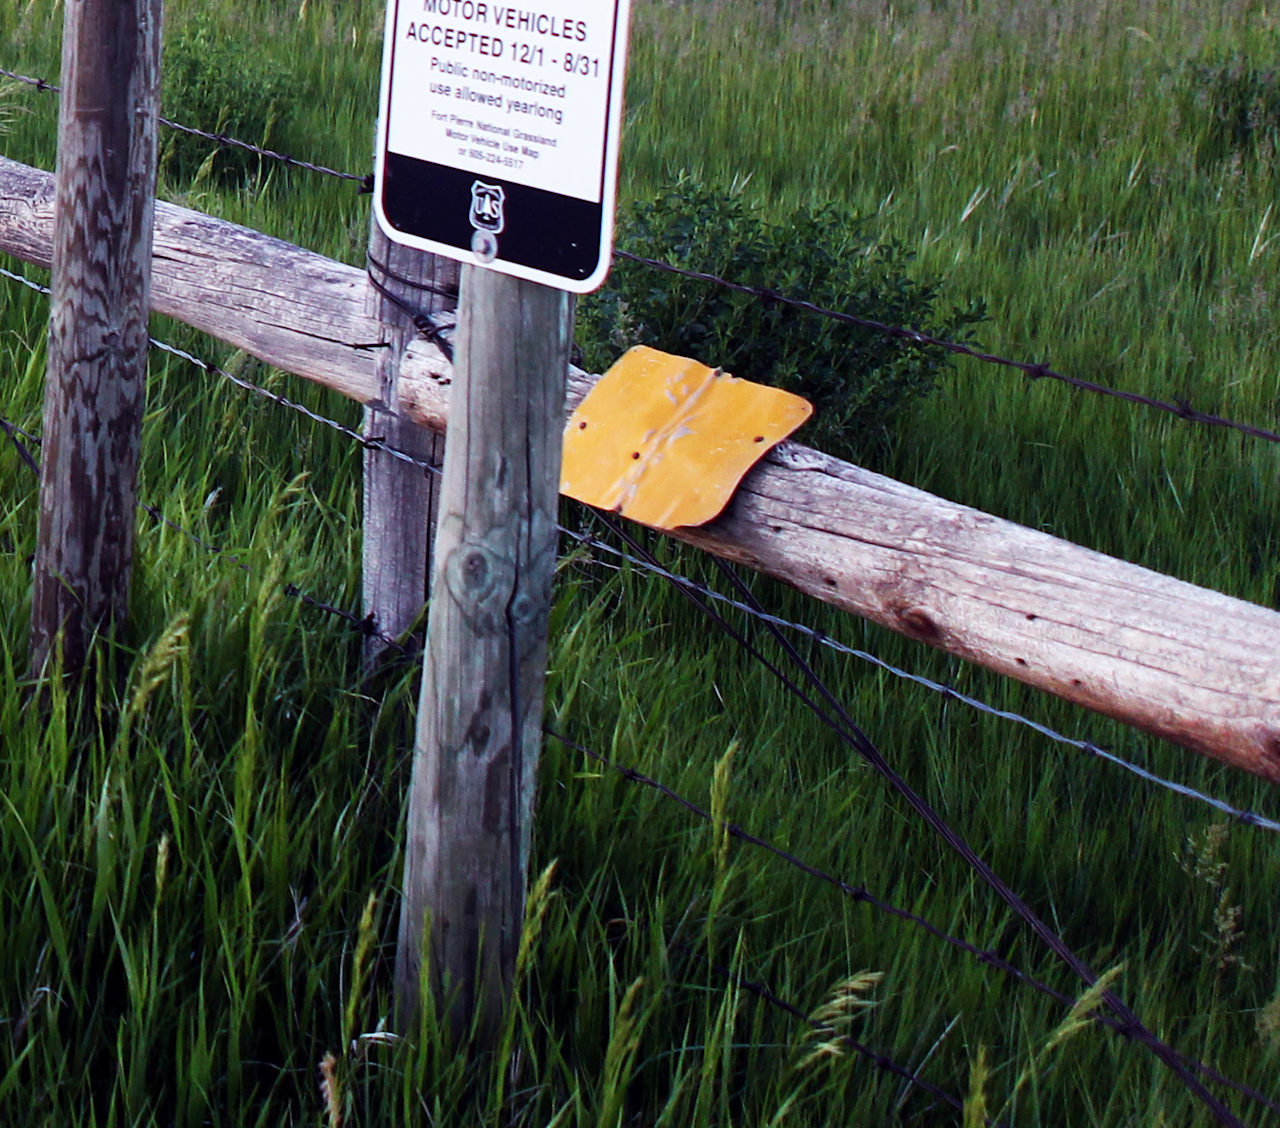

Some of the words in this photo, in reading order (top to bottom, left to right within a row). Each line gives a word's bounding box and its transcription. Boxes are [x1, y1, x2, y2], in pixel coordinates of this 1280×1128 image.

[493, 6, 587, 41] VEHICLES
[406, 22, 503, 57] ACCEPTED
[510, 42, 545, 67] 12/1
[563, 53, 600, 78] 8/31
[430, 57, 468, 78] Public
[472, 68, 566, 99] non-motorized
[430, 81, 451, 97] use
[455, 86, 503, 109] allowed
[506, 100, 563, 125] yearlong
[445, 127, 469, 141] Motor
[470, 133, 500, 150] Vehicle
[476, 121, 511, 136] National
[512, 129, 558, 148] Grassland
